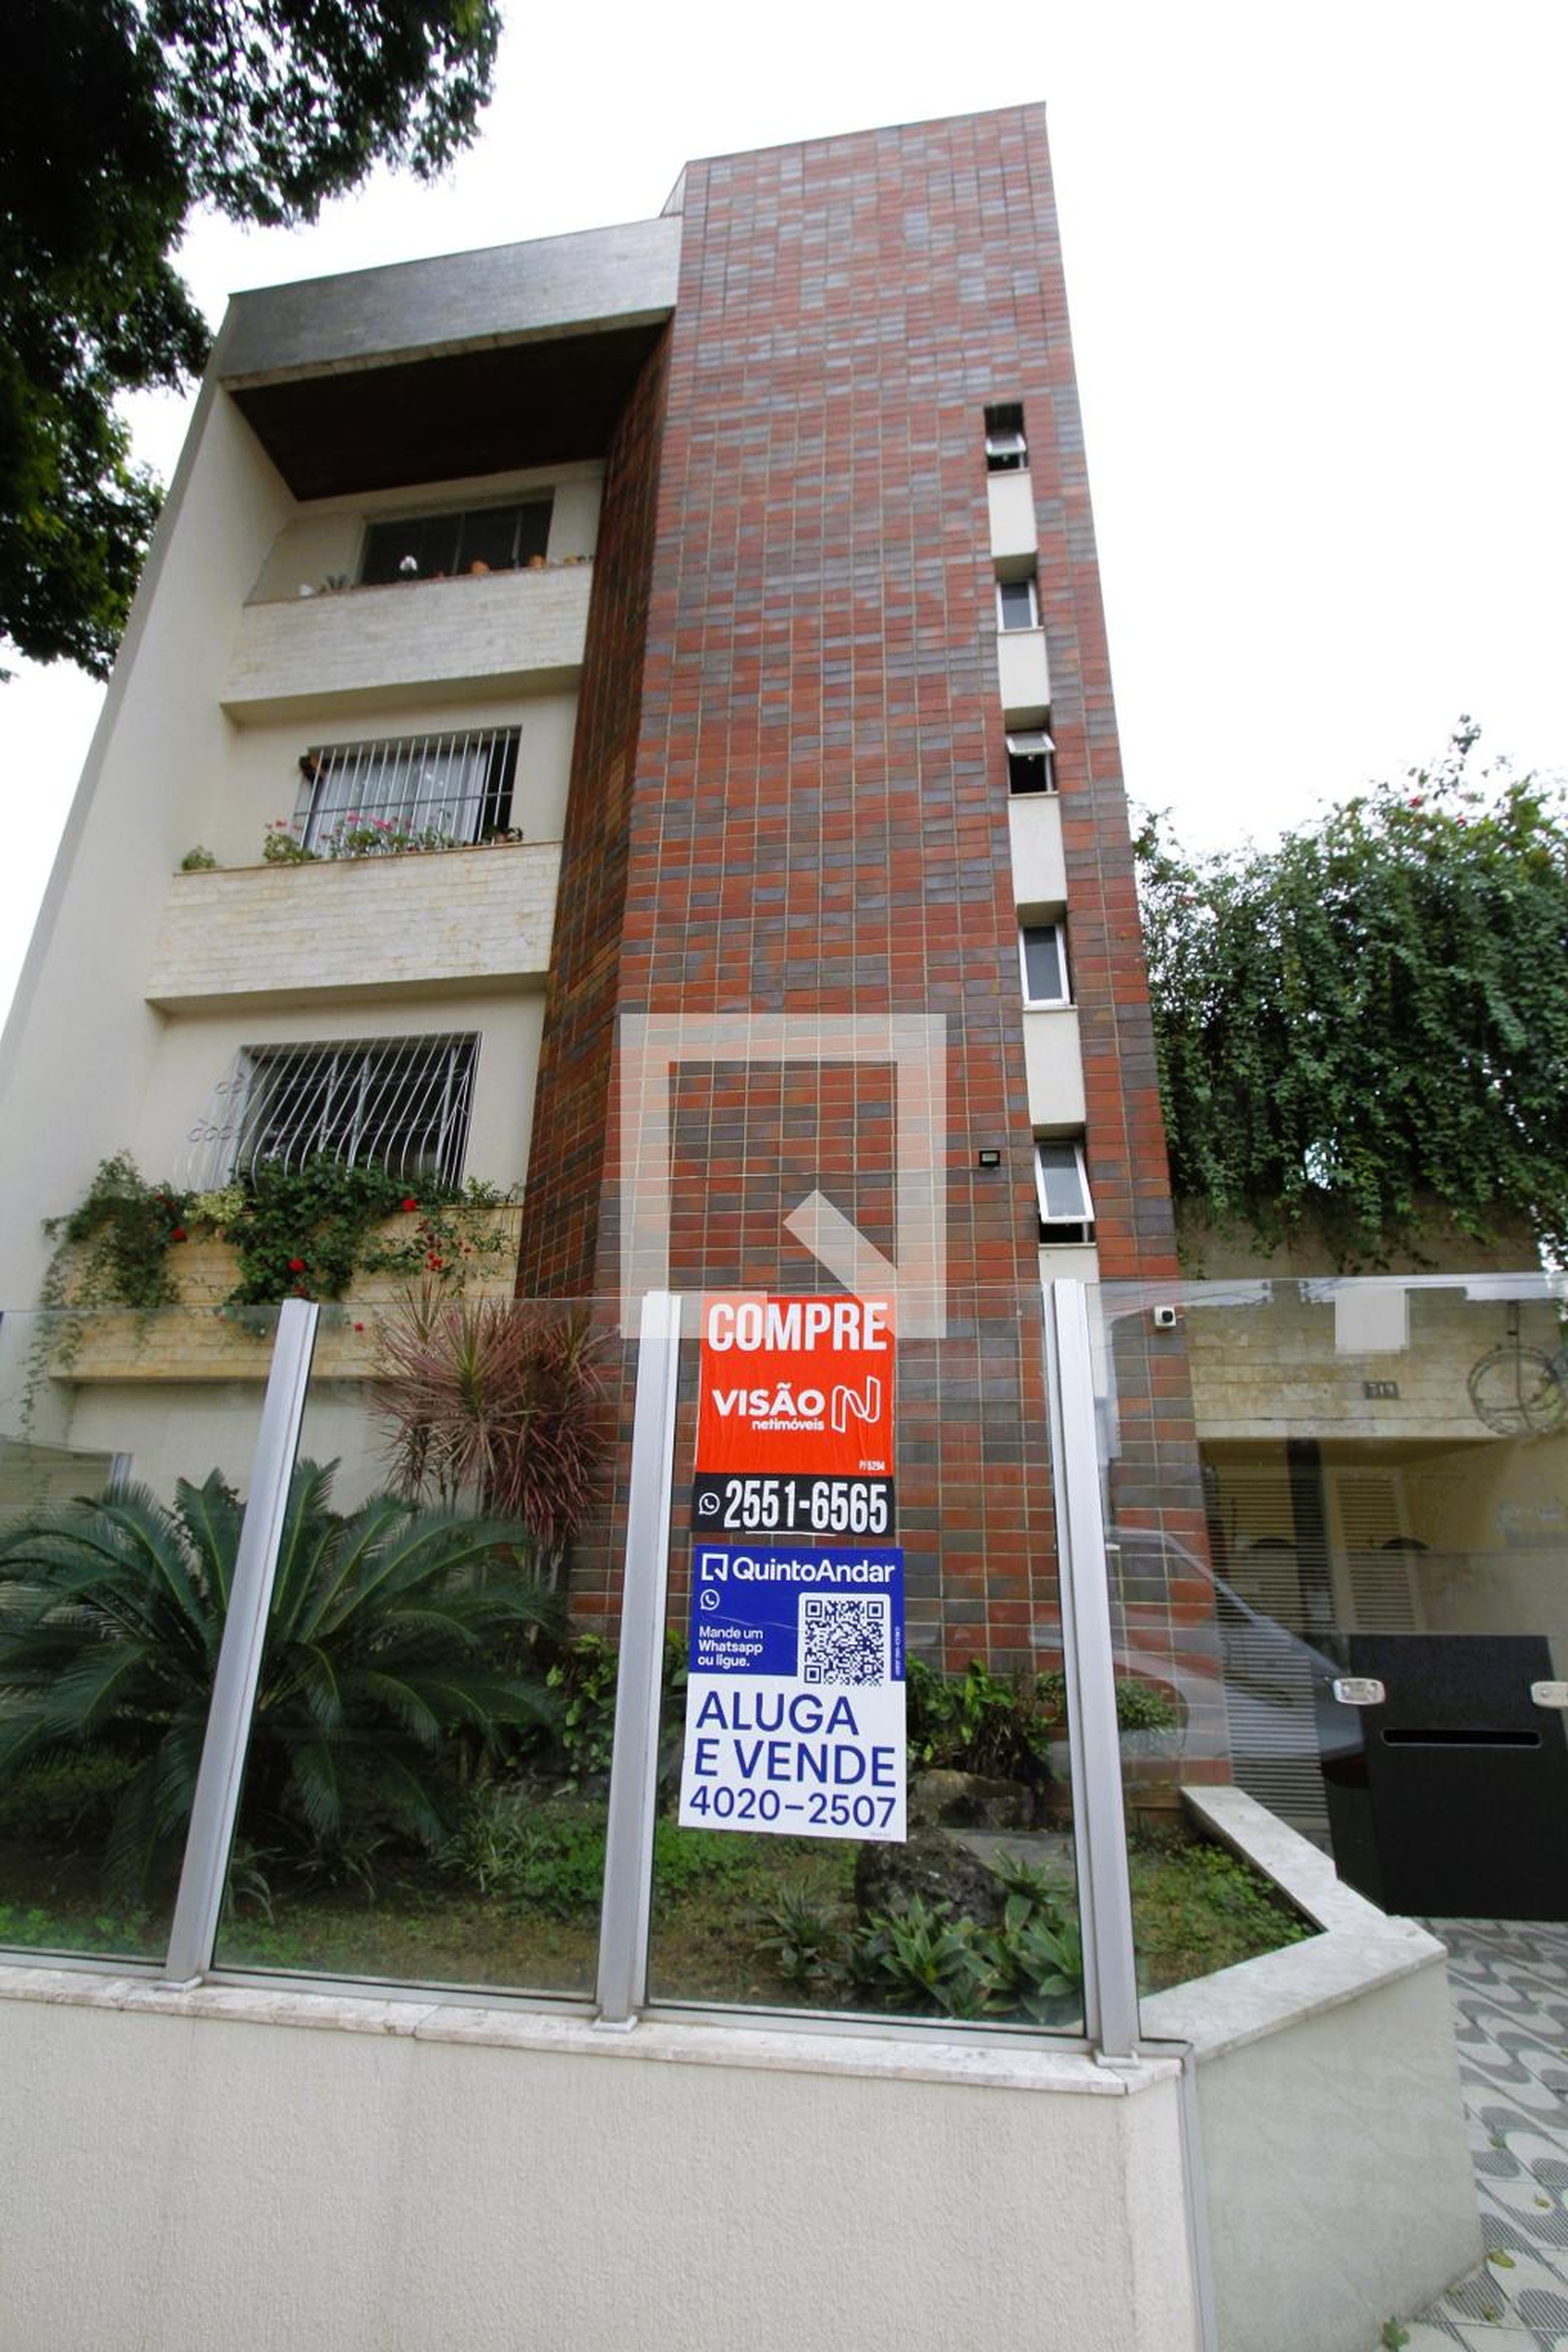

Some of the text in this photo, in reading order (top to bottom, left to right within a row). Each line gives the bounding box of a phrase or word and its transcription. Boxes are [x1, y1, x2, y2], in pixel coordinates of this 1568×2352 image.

[708, 1302, 889, 1352] COMPRE
[712, 1382, 825, 1417] VISÃO
[752, 1419, 824, 1431] netimóveis
[724, 1480, 887, 1534] 2551-6565
[733, 1556, 895, 1583] QuintoAndar
[698, 1639, 763, 1655] Whatsapp
[699, 1626, 763, 1639] Mande um
[698, 1654, 750, 1669] ou ligue.
[696, 1690, 860, 1736] ALUGA
[695, 1738, 896, 1787] E VENDE
[689, 1785, 896, 1828] 4020-2507
